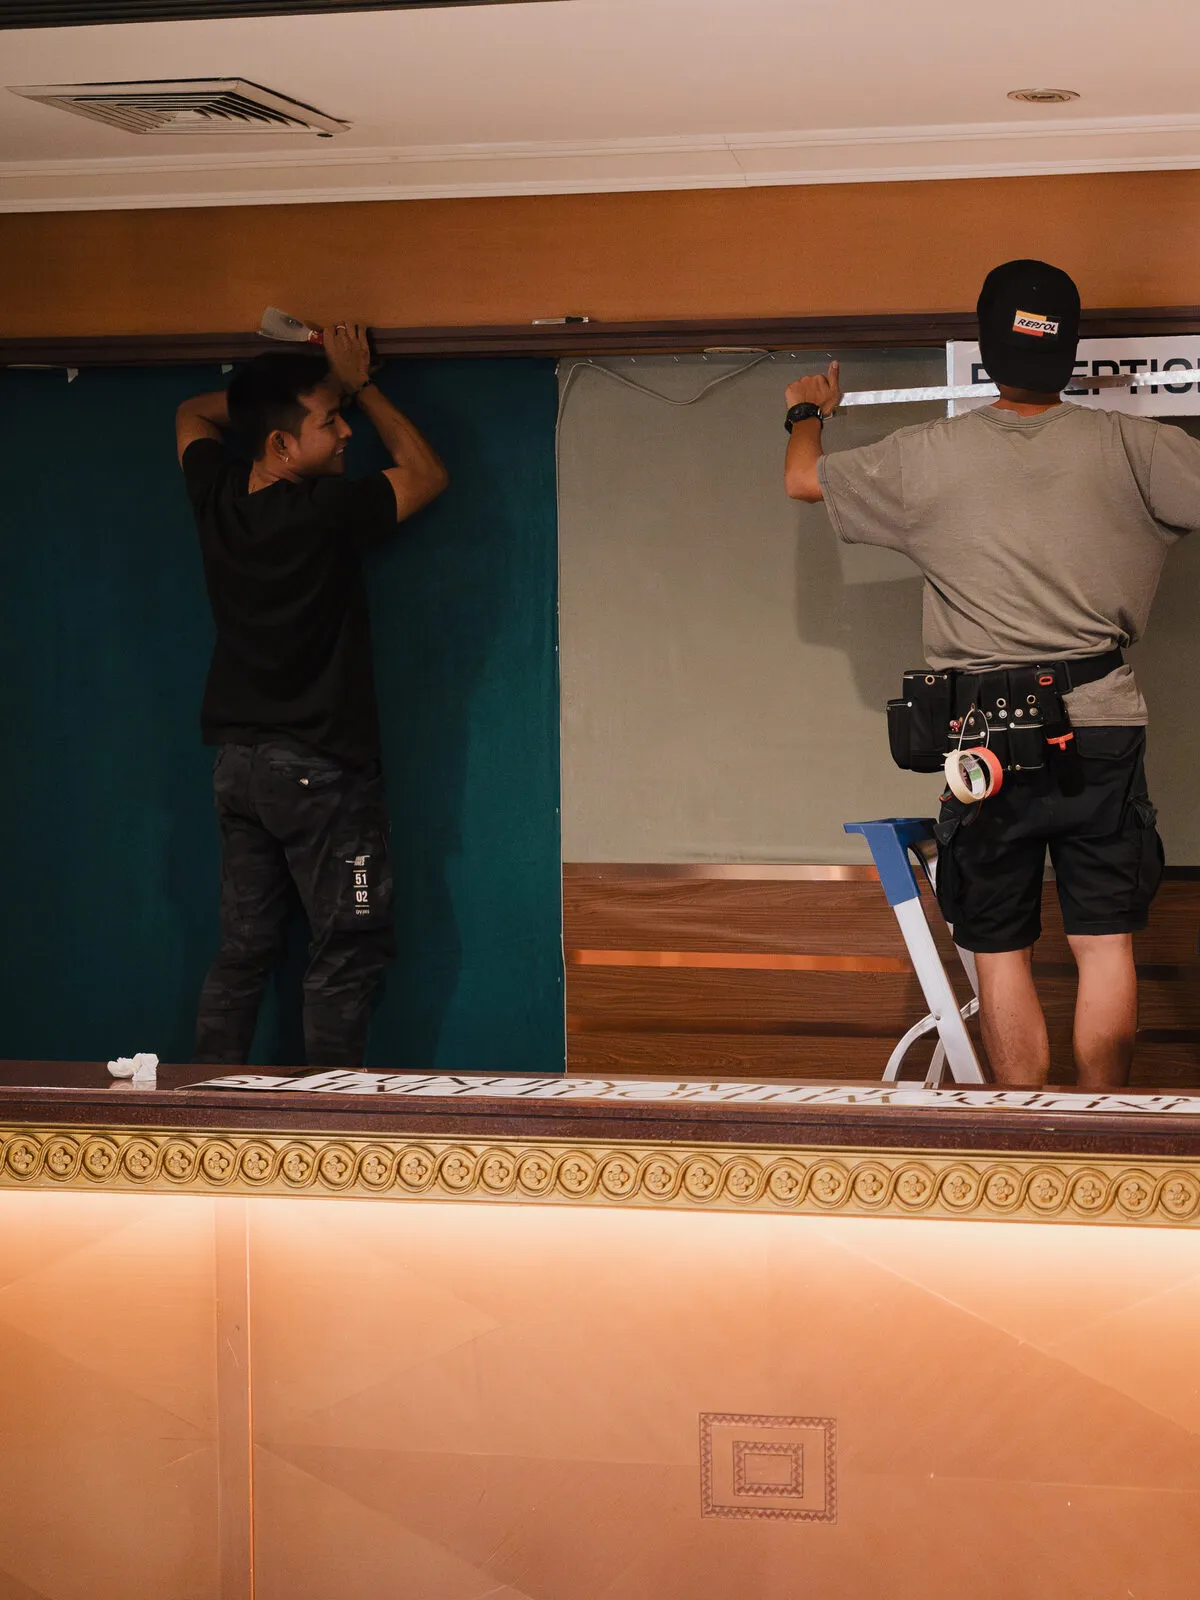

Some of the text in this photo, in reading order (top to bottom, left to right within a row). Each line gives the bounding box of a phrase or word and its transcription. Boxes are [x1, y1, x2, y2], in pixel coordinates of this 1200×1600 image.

[1017, 318, 1056, 331] REPSOL
[355, 873, 367, 885] 51
[356, 890, 368, 902] 02
[328, 1072, 649, 1090] LUXURY
